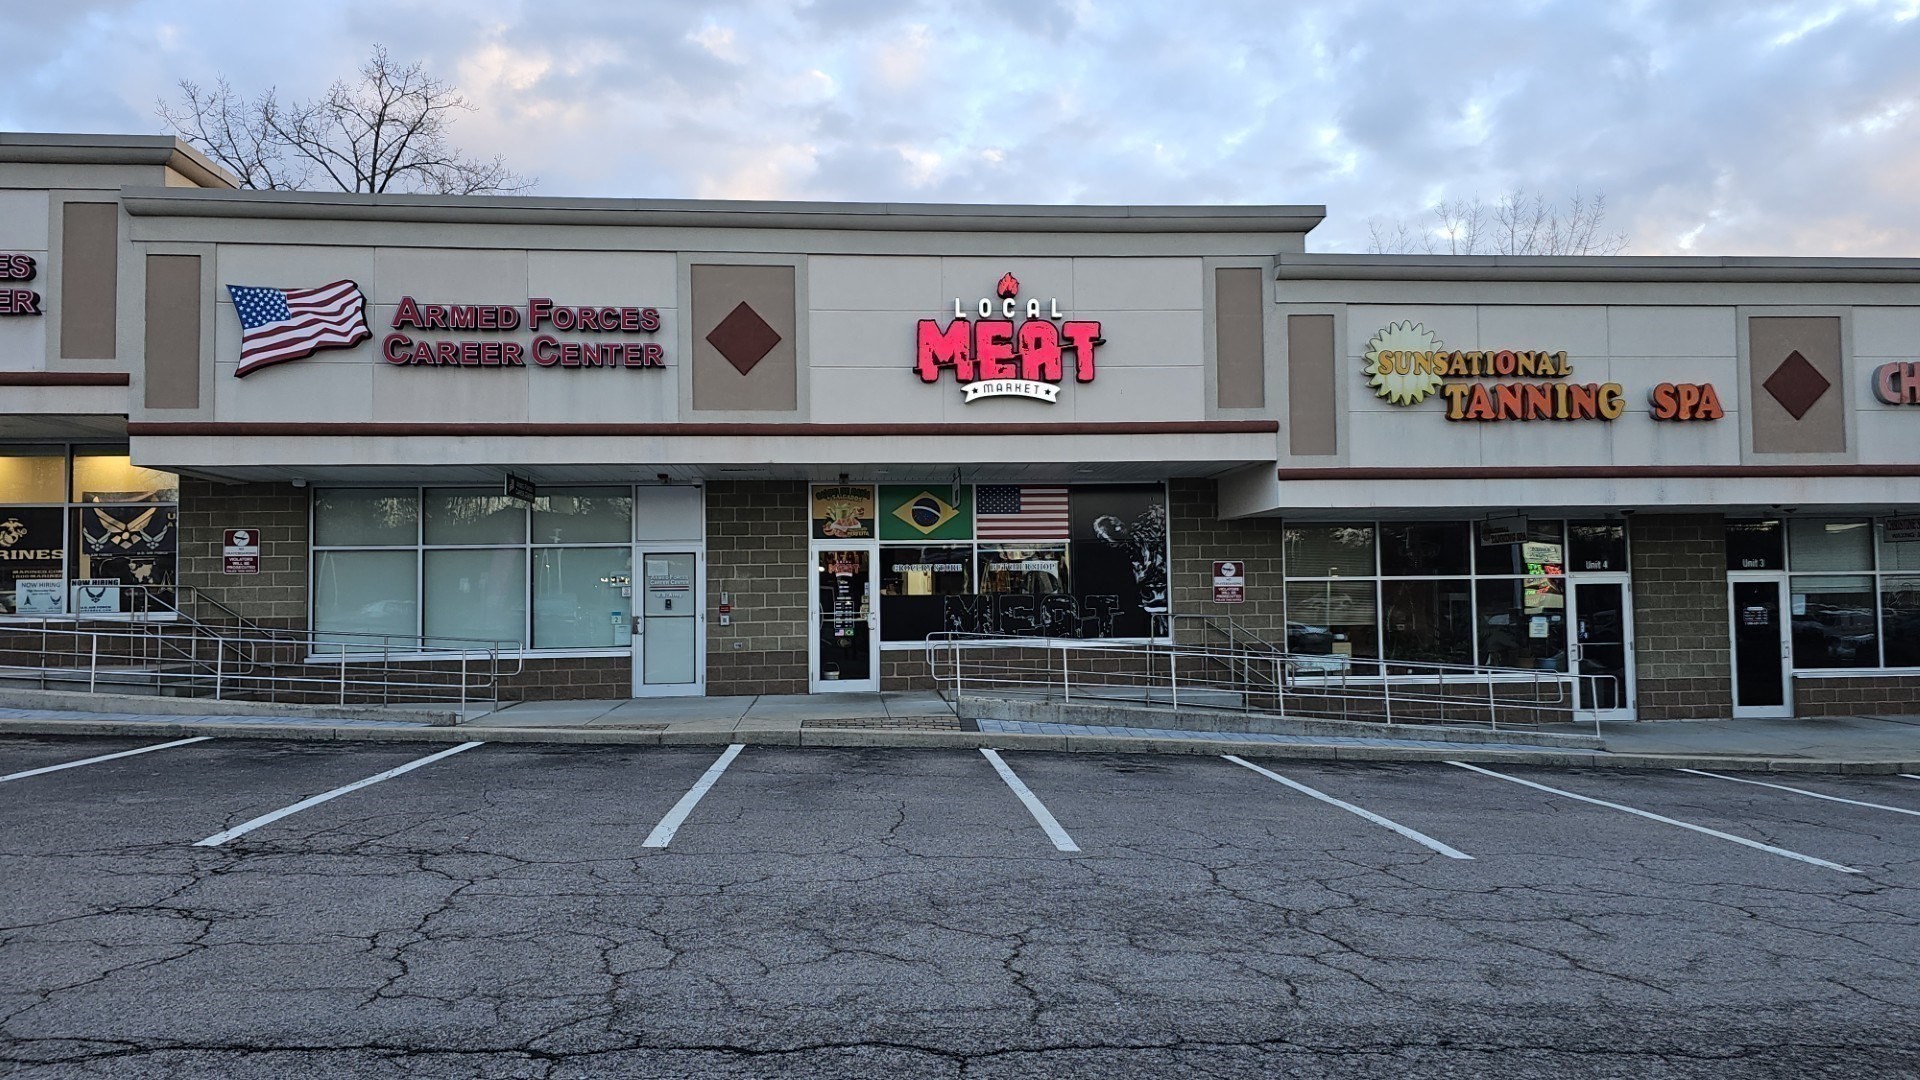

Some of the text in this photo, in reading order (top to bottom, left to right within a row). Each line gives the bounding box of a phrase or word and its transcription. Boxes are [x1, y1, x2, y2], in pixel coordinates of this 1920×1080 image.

[390, 295, 660, 332] ARMED FORCES
[954, 297, 1063, 319] LOCAL
[382, 333, 666, 369] CAREER CENTER
[915, 318, 1103, 384] MEAT
[1377, 350, 1574, 378] SUNSATIONAL
[983, 383, 1040, 395] MARKET
[1871, 361, 1920, 405] CH
[1443, 382, 1724, 421] TANNING SPA
[892, 563, 963, 573] GROCERY STORE
[1032, 562, 1056, 571] SHOP
[1585, 560, 1609, 570] Unit 4
[1742, 558, 1765, 568] Unit 3
[944, 594, 1122, 640] MEAT
